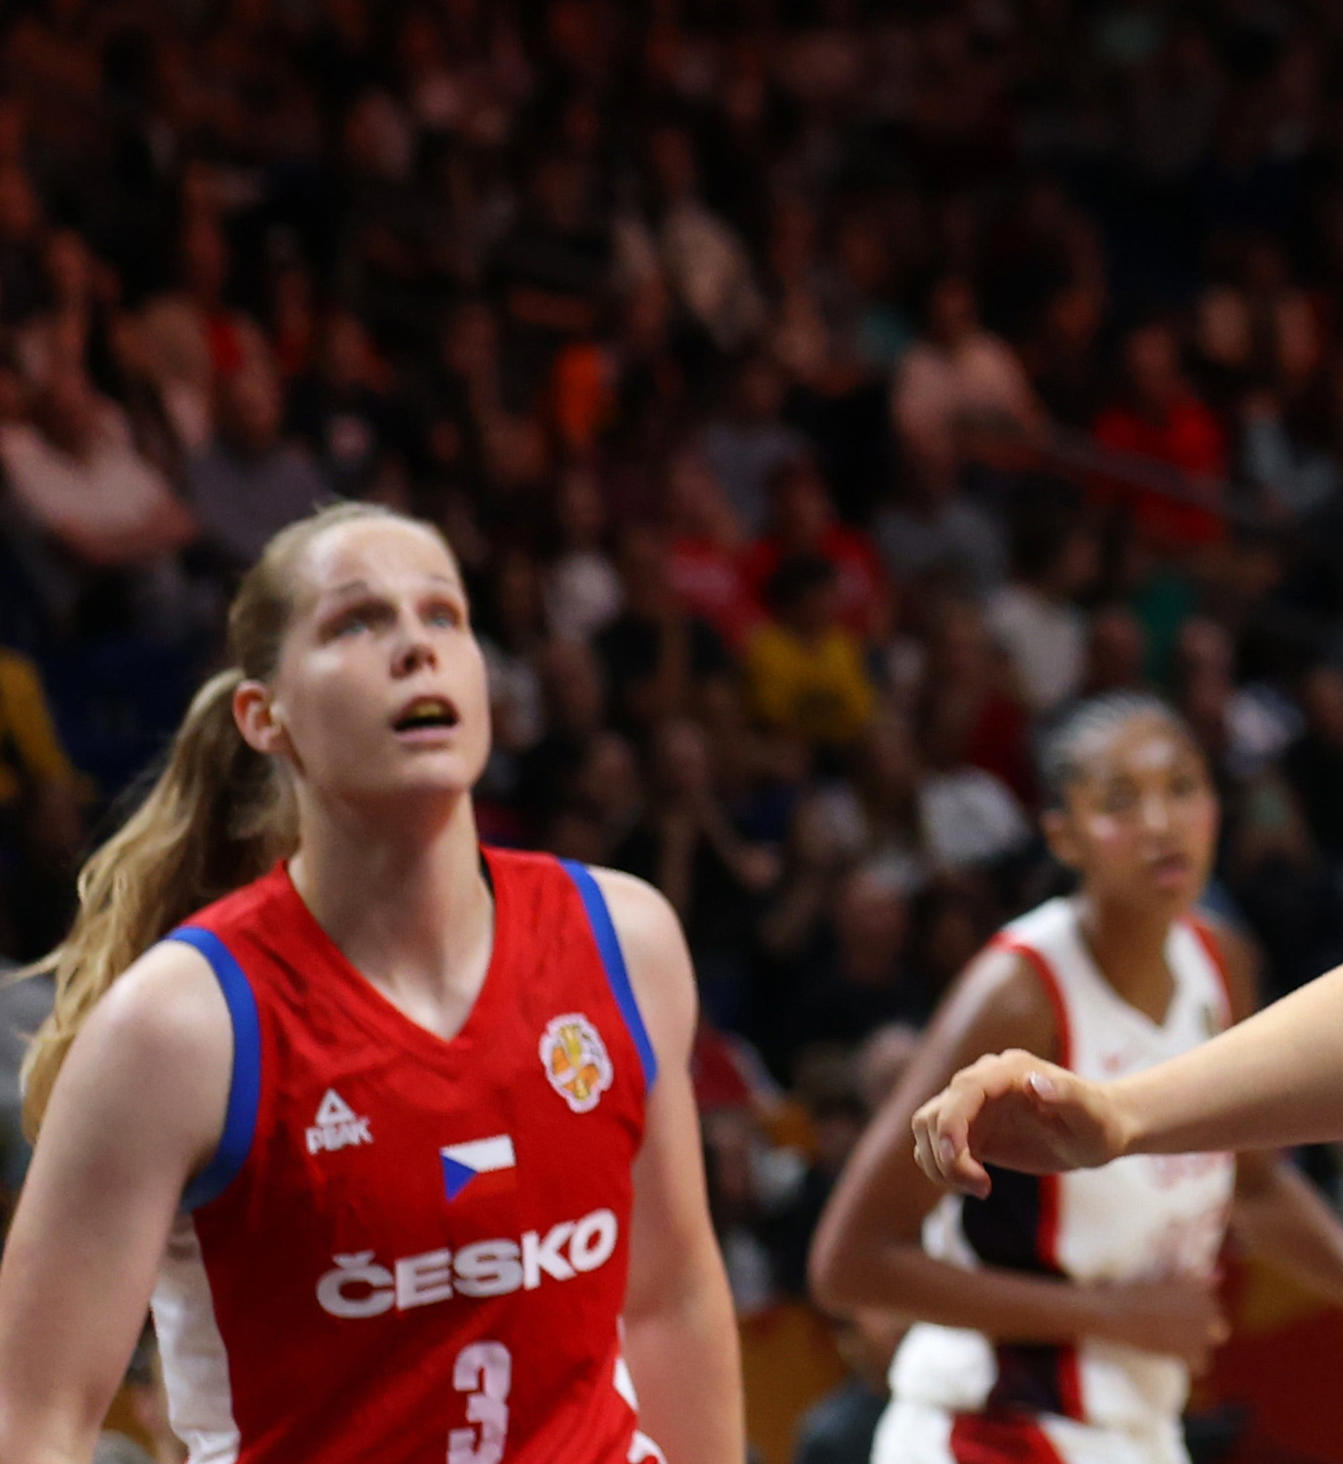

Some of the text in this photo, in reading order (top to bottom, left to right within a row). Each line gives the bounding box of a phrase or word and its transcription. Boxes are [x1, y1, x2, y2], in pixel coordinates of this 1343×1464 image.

[305, 1116, 374, 1156] PEAK
[315, 1209, 618, 1320] ČESKO
[447, 1340, 512, 1464] 3
